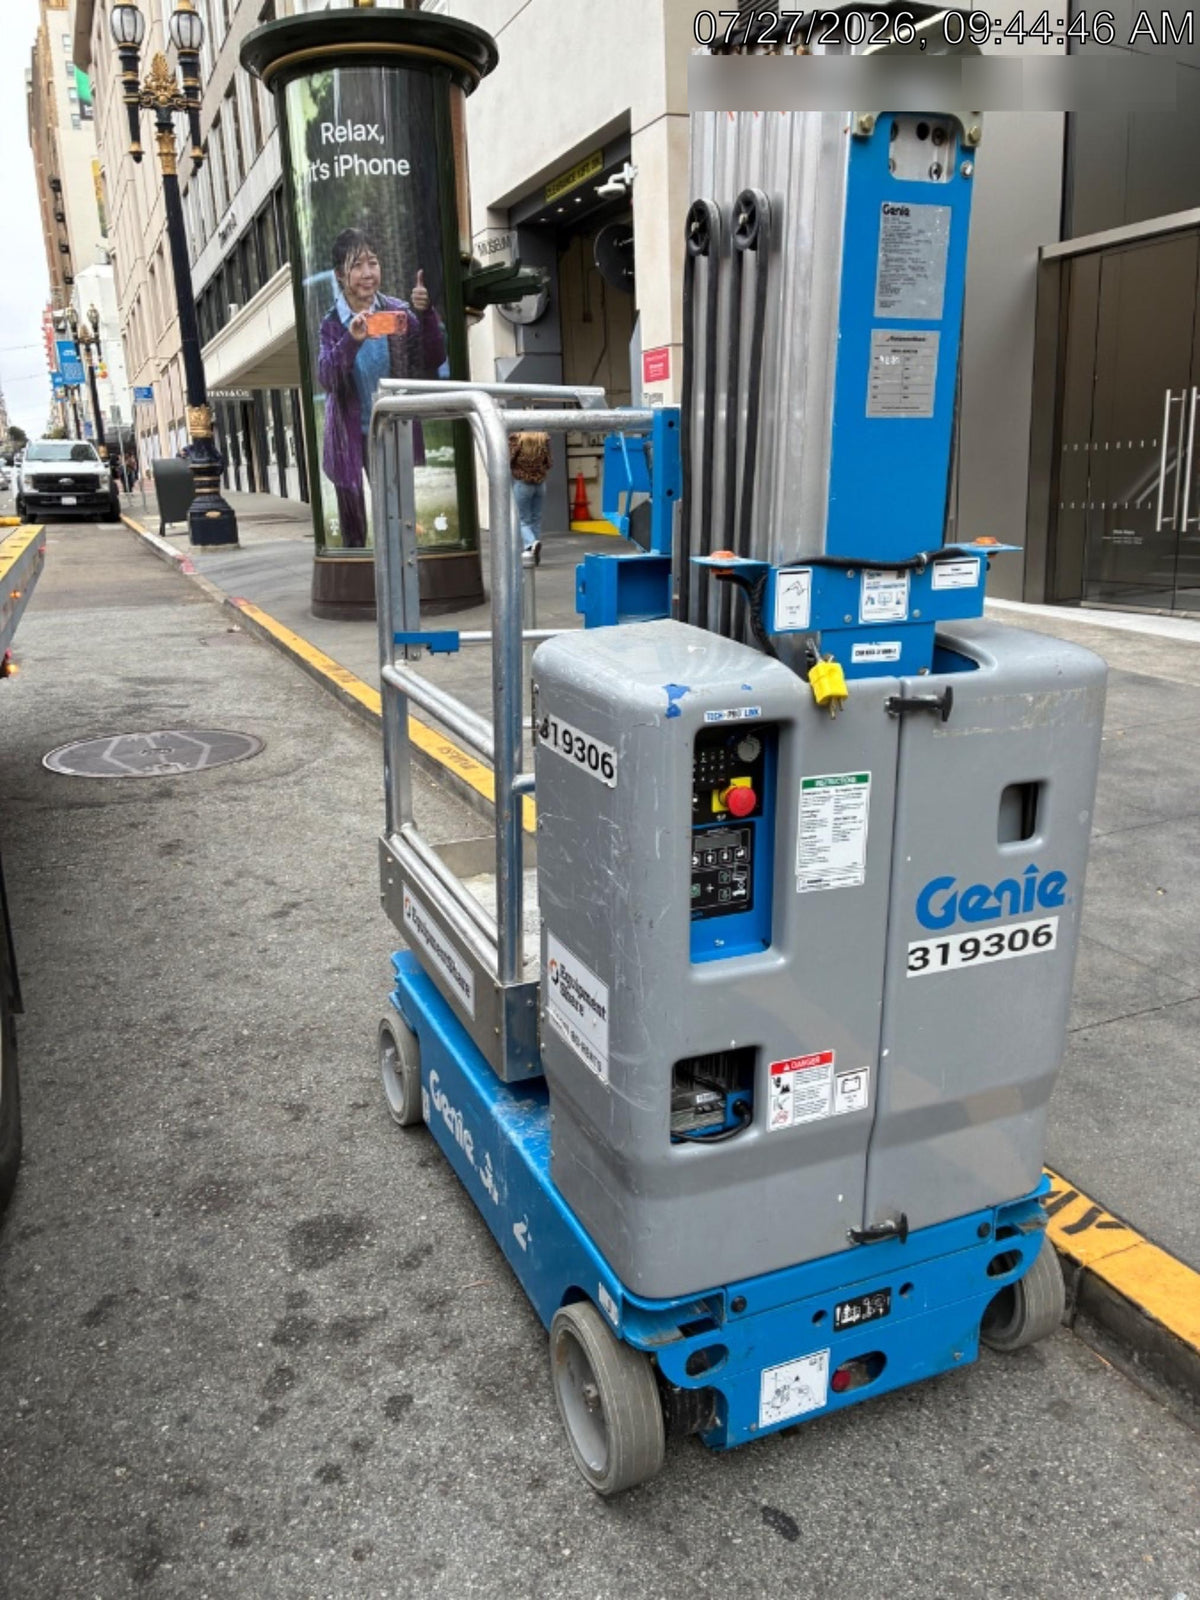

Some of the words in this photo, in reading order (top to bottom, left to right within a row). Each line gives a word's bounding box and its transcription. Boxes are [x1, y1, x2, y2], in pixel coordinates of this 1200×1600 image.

[321, 119, 385, 145] Relax,
[333, 153, 411, 178] iPhone
[882, 204, 910, 217] Genie
[915, 863, 1069, 931] Genie
[907, 923, 1054, 972] 319306
[560, 962, 606, 1020] Equipment
[560, 981, 584, 1017] Share
[429, 1068, 475, 1169] Genie
